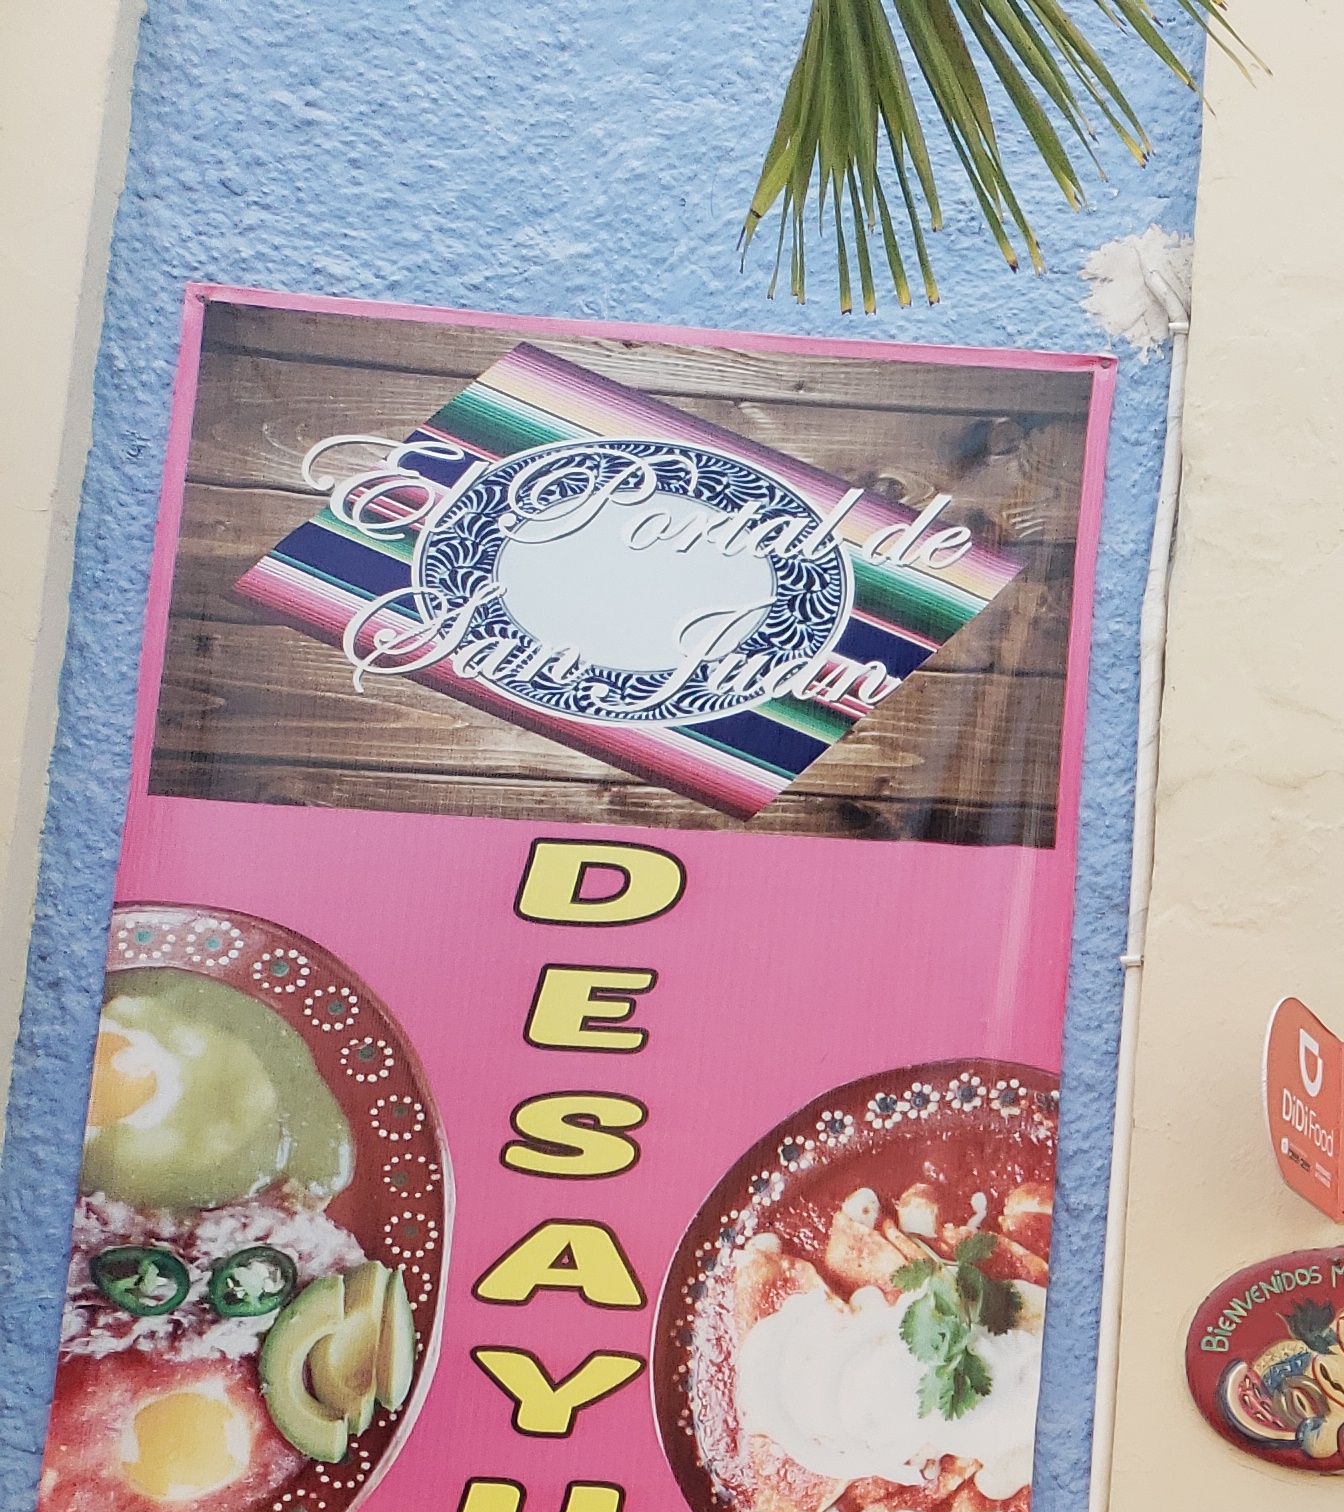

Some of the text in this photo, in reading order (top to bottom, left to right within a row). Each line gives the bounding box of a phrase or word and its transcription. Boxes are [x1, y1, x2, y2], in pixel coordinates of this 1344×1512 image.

[302, 434, 971, 572] El Portal de
[344, 582, 904, 711] San Juan
